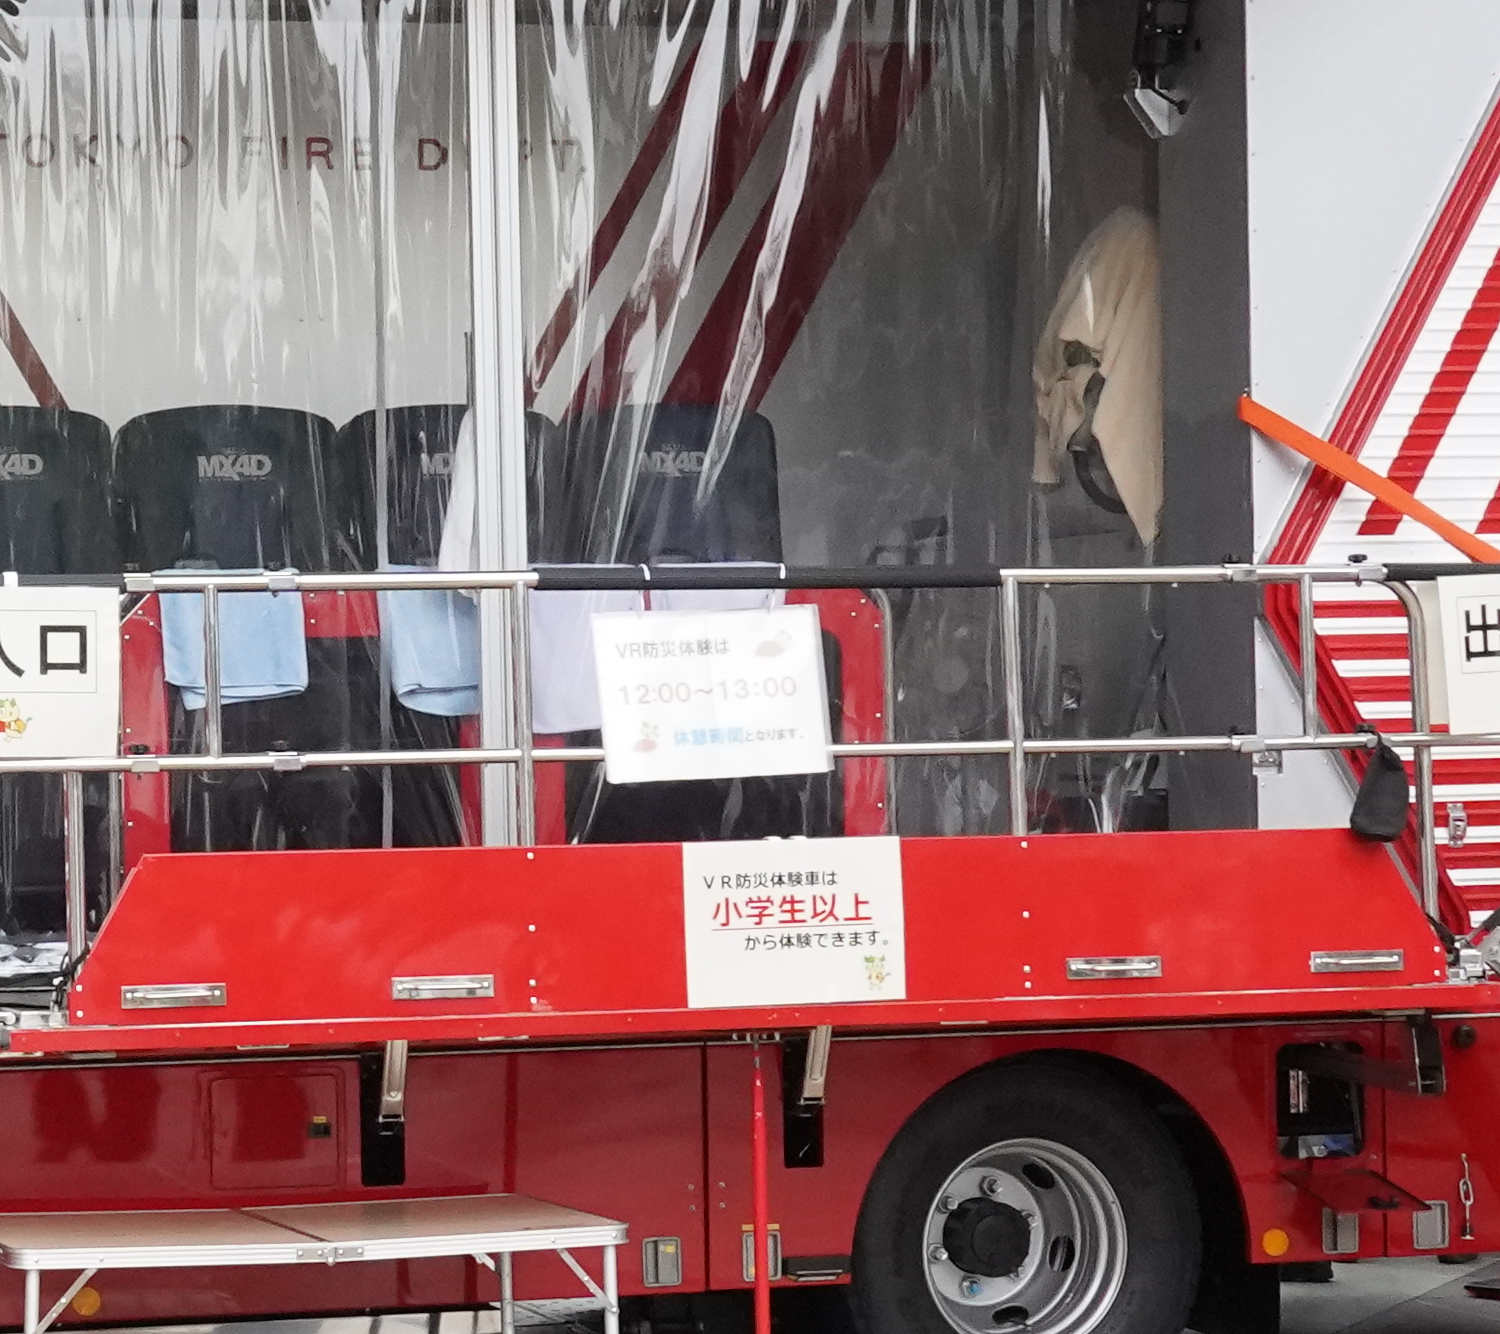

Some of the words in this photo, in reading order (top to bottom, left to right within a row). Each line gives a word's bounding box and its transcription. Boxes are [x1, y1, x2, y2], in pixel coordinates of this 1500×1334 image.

[615, 638, 730, 659] VR防災体験は
[703, 871, 838, 889] VR防災体験車は
[712, 892, 873, 927] 小学生以上
[744, 930, 889, 951] から体験できます。
